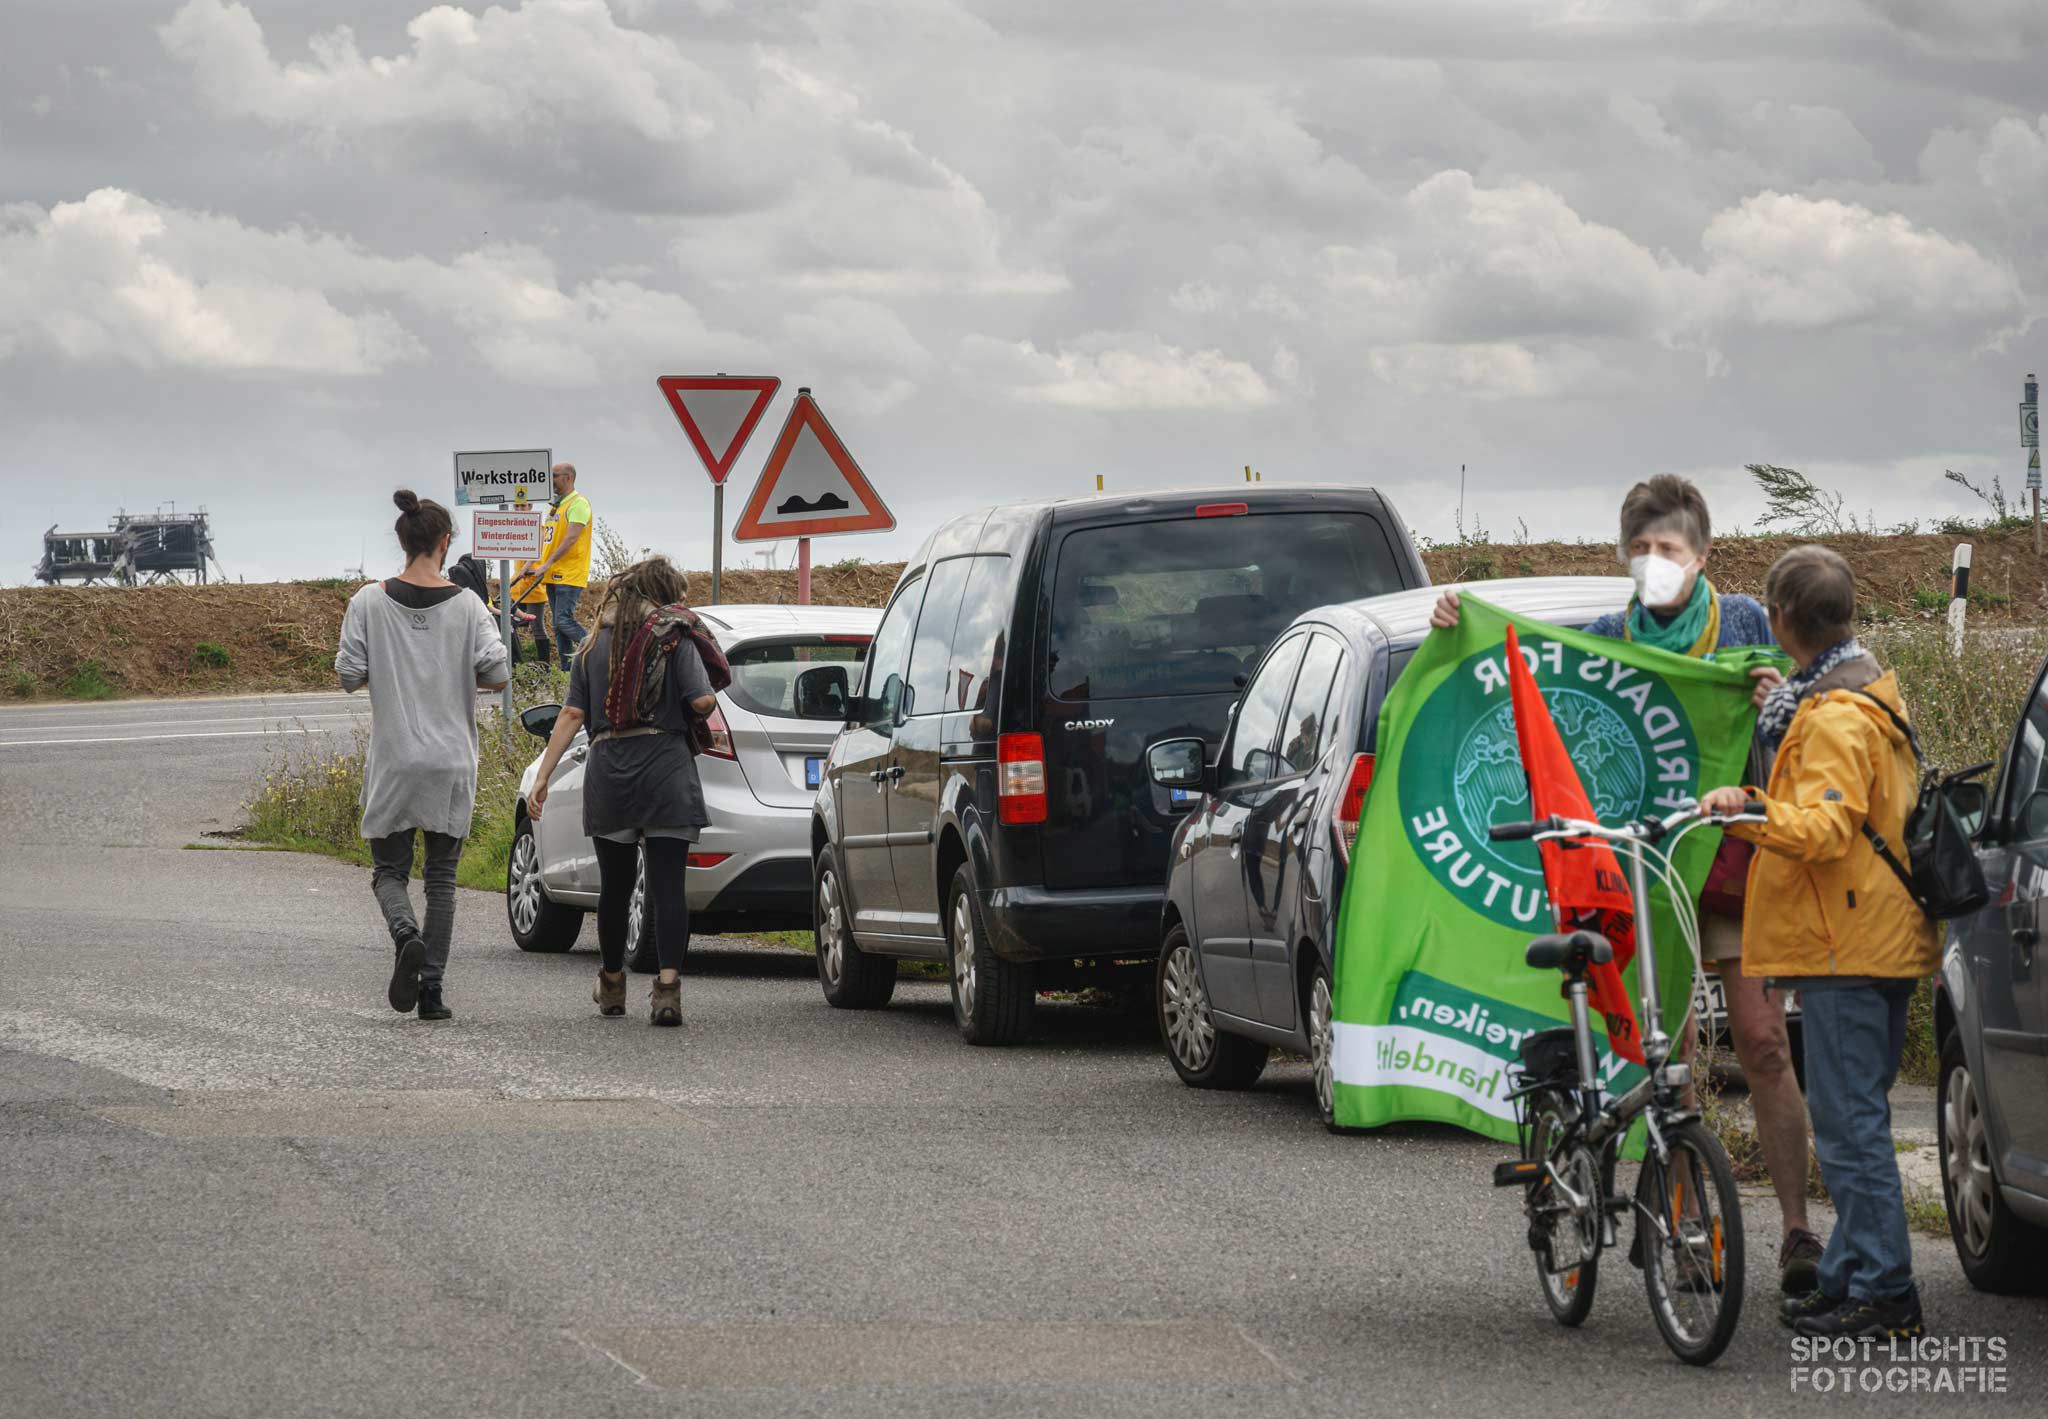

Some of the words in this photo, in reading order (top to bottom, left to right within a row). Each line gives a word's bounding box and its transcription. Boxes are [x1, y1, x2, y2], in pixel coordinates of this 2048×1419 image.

[461, 468, 546, 485] Werkstraße
[477, 516, 537, 527] Eingeschränkter
[481, 532, 528, 540] Winterdienst
[1065, 718, 1115, 731] CADDY
